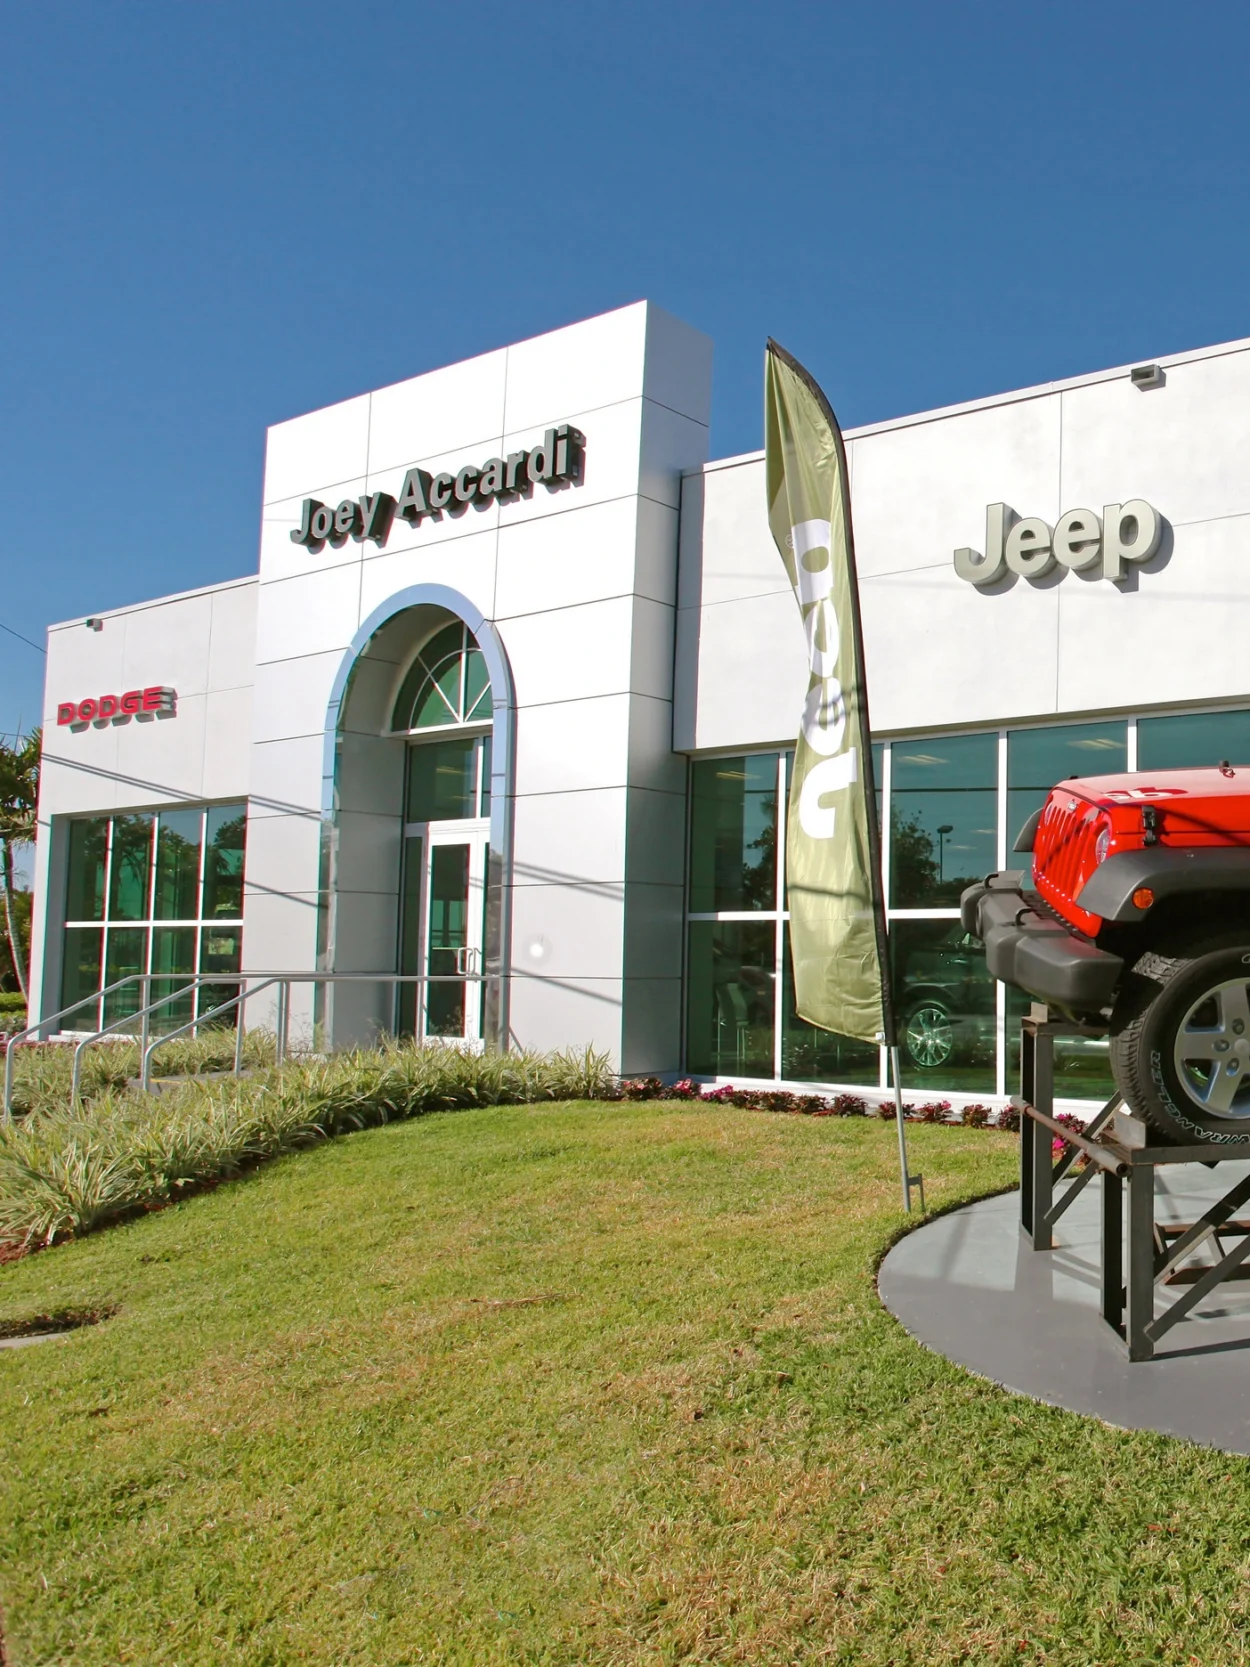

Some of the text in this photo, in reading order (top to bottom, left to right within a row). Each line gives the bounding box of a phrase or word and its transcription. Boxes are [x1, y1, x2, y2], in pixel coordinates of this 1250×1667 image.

[290, 424, 583, 547] Joey Accardi
[954, 498, 1160, 585] Jeep
[57, 685, 174, 728] DODGE
[792, 518, 858, 839] Jeep
[1150, 1050, 1250, 1144] WRANGLER
